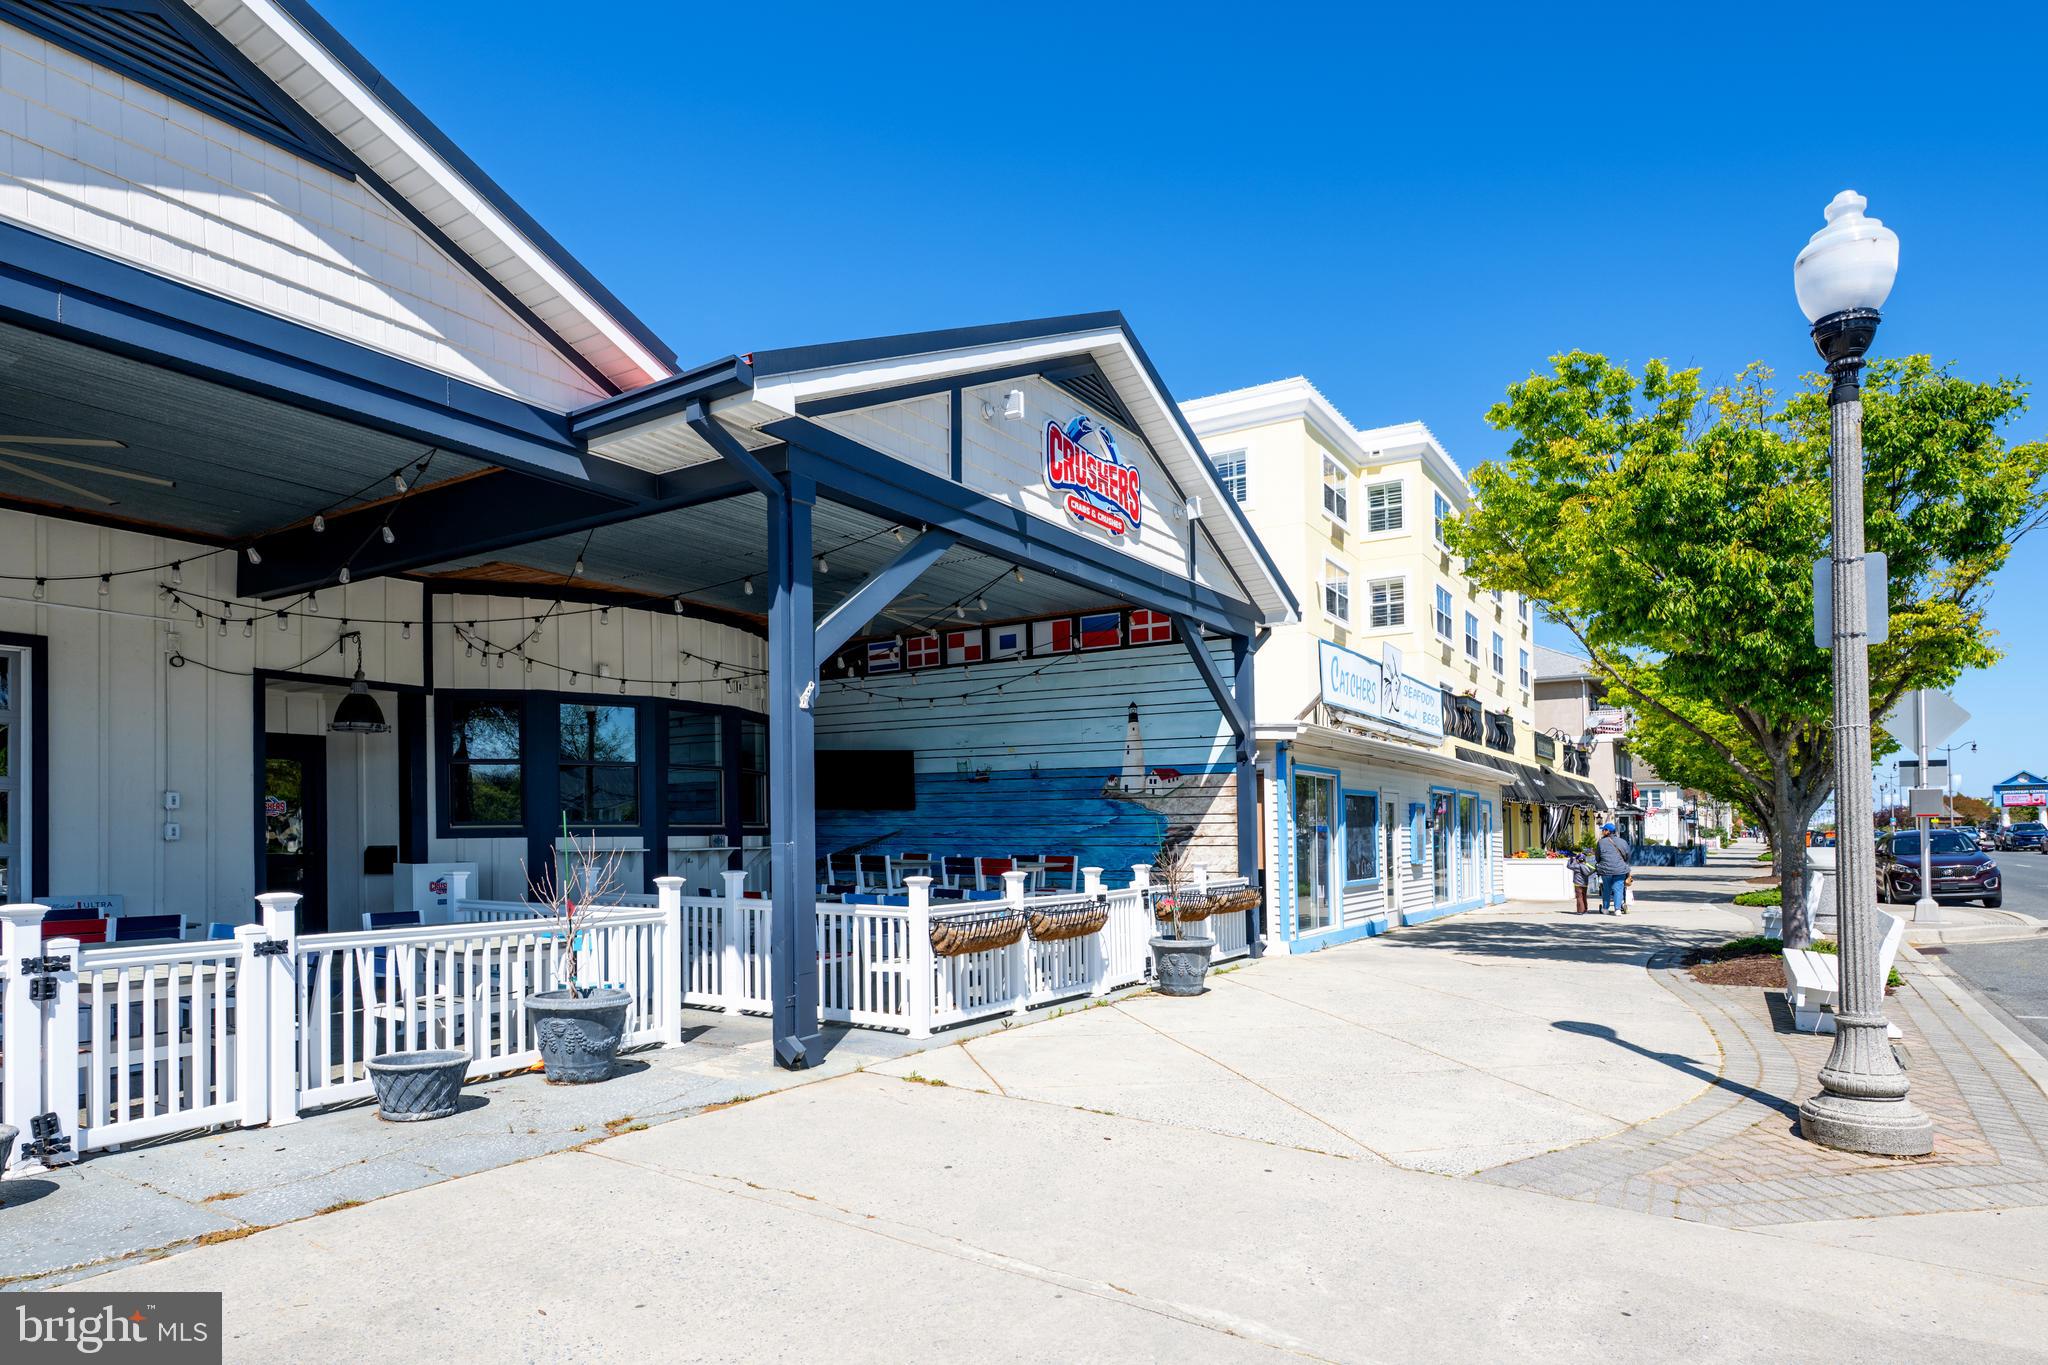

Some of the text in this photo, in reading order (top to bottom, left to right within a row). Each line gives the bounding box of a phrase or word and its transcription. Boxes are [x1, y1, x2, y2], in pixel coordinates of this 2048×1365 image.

[1049, 424, 1140, 523] CRUSHERS
[1070, 500, 1091, 515] CRABS
[1091, 509, 1098, 518] &
[1404, 685, 1434, 706] SEAFOOD
[1422, 711, 1440, 727] BEER
